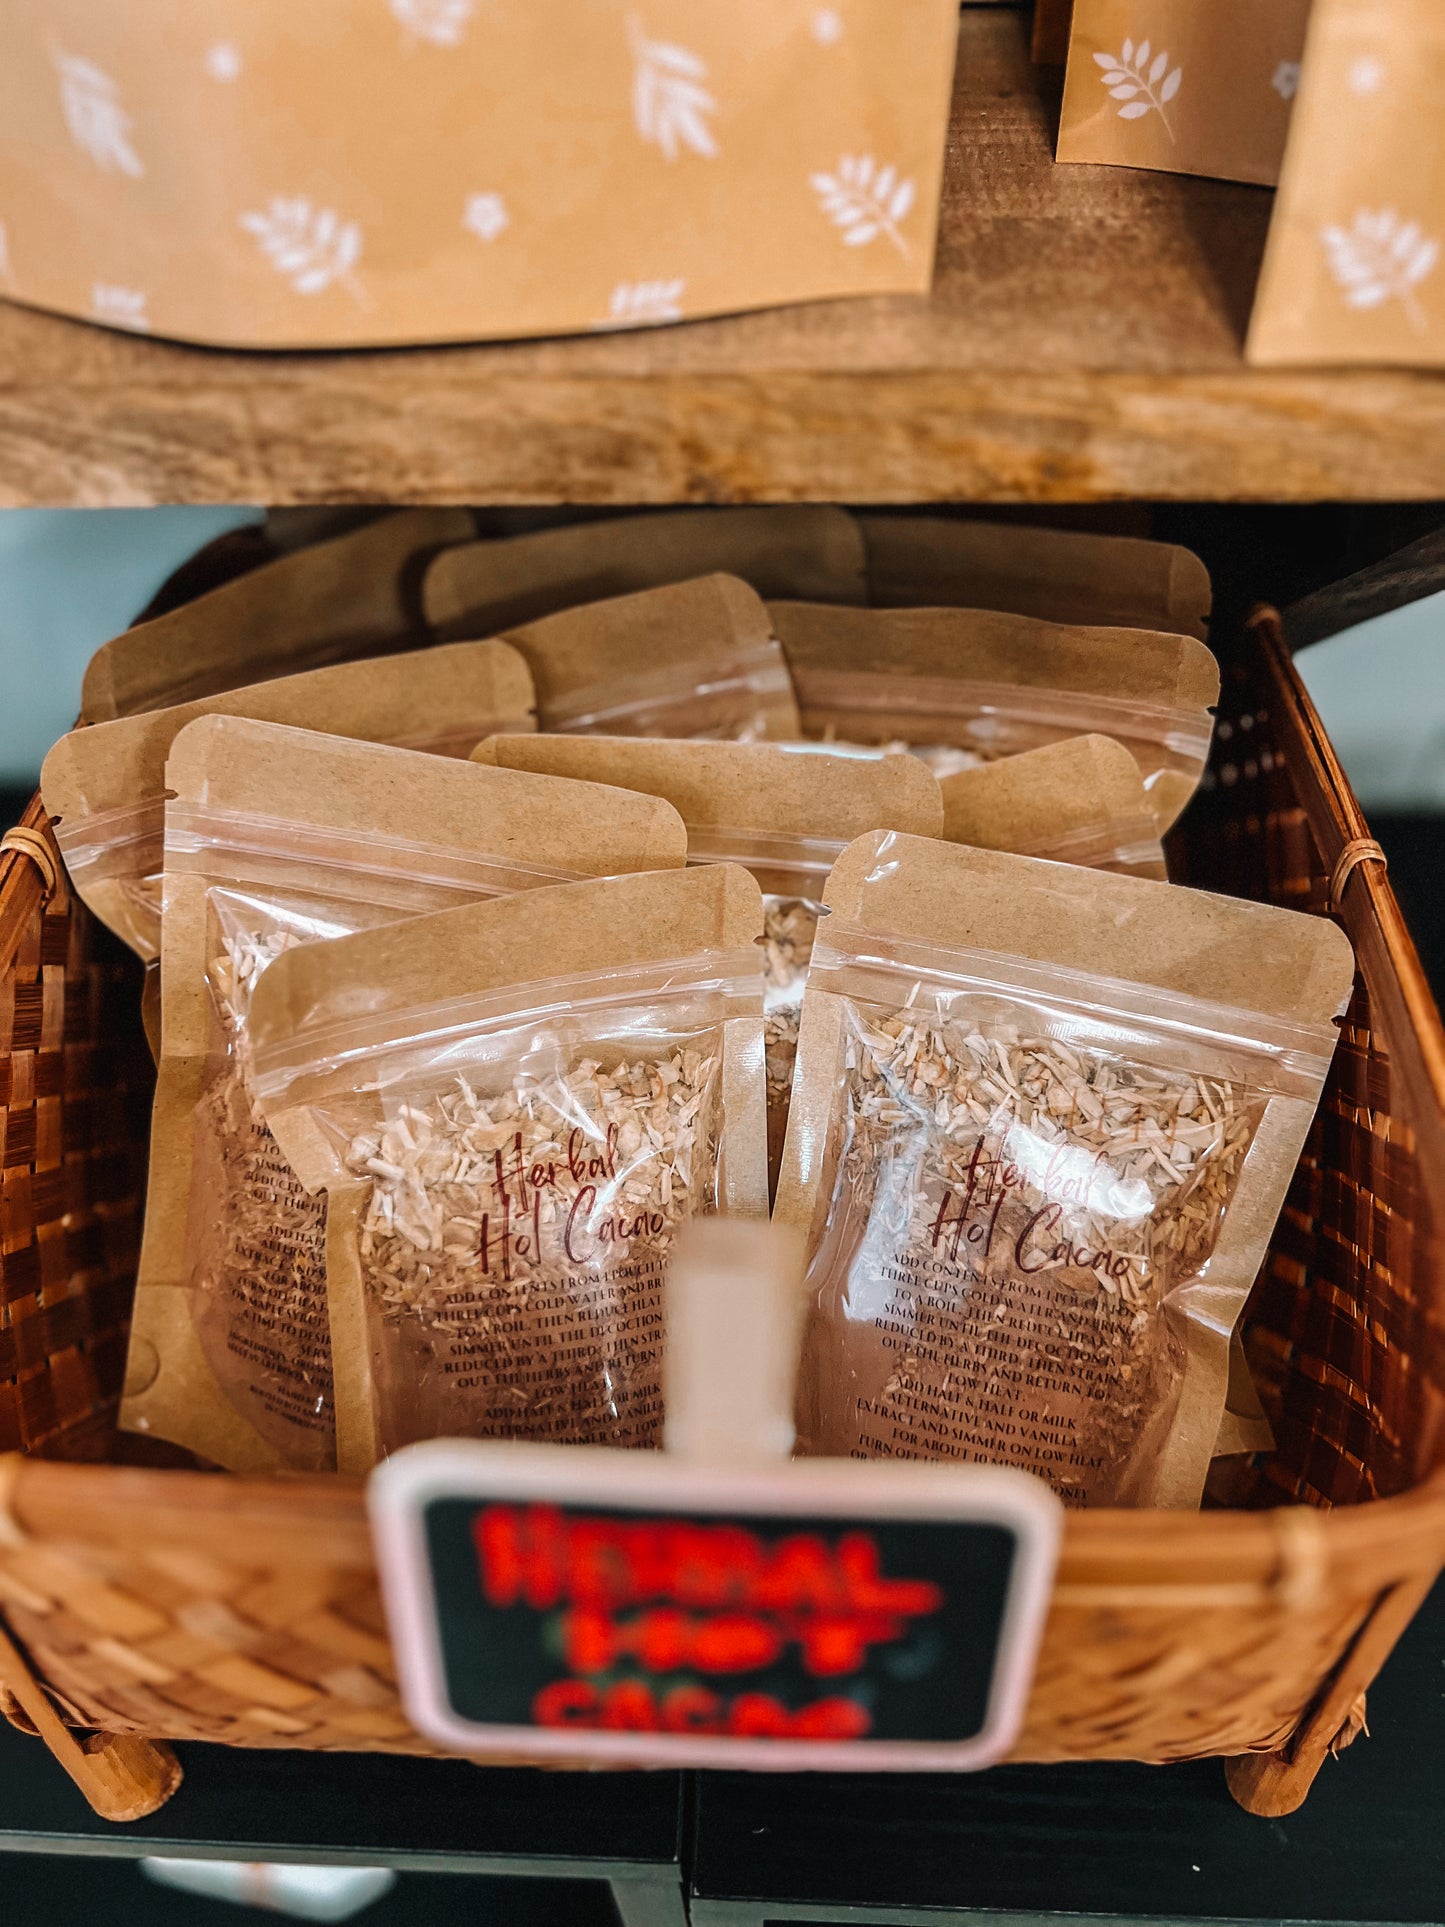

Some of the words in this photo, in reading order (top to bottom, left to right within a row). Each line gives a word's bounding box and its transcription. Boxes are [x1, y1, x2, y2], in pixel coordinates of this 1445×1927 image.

[491, 1123, 618, 1217] Herbal
[962, 1124, 1109, 1207] Herbal
[565, 1185, 664, 1264] Cacao
[1015, 1203, 1130, 1276] Cacao
[893, 1252, 919, 1268] ADD
[525, 1297, 565, 1312] COLD
[567, 1288, 616, 1305] WATER
[880, 1266, 921, 1287] THREE
[924, 1278, 959, 1296] CUPS
[961, 1287, 1000, 1305] COLD
[536, 1314, 574, 1329] THEN
[577, 1303, 628, 1322] REDUCE
[884, 1303, 935, 1326] SIMMER
[939, 1317, 980, 1337] UNTIL
[894, 1287, 912, 1301] TO
[968, 1306, 1005, 1325] THEN
[450, 1341, 507, 1356] SIMMER
[559, 1329, 588, 1344] THE
[590, 1312, 663, 1338] DECOCTION
[875, 1317, 937, 1342] REDUCED
[940, 1335, 954, 1348] BY
[1028, 1358, 1065, 1375] THEN
[444, 1357, 513, 1374] REDUCED
[881, 1336, 912, 1353] OUT
[943, 1354, 987, 1373] HERBS
[990, 1367, 1022, 1382] AND
[1026, 1374, 1081, 1394] RETURN
[947, 1372, 980, 1389] LOW
[633, 1382, 661, 1399] MILK
[898, 1376, 924, 1392] ADD
[926, 1384, 961, 1403] HALF
[978, 1399, 1013, 1417] HALF
[1018, 1408, 1039, 1422] OR
[1042, 1414, 1077, 1430] MILK
[857, 1397, 915, 1426] EXTRACT
[919, 1418, 949, 1436] AND
[952, 1428, 1006, 1452] SIMMER
[1010, 1442, 1032, 1456] ON
[1035, 1447, 1067, 1462] LOW
[890, 1392, 981, 1427] ALTERNATIVE
[985, 1419, 1016, 1435] AND
[1020, 1426, 1078, 1448] VANILLA
[859, 1433, 893, 1454] TURN
[892, 1427, 918, 1445] FOR
[920, 1438, 970, 1460] ABOUT
[1050, 1484, 1087, 1499] ONEY
